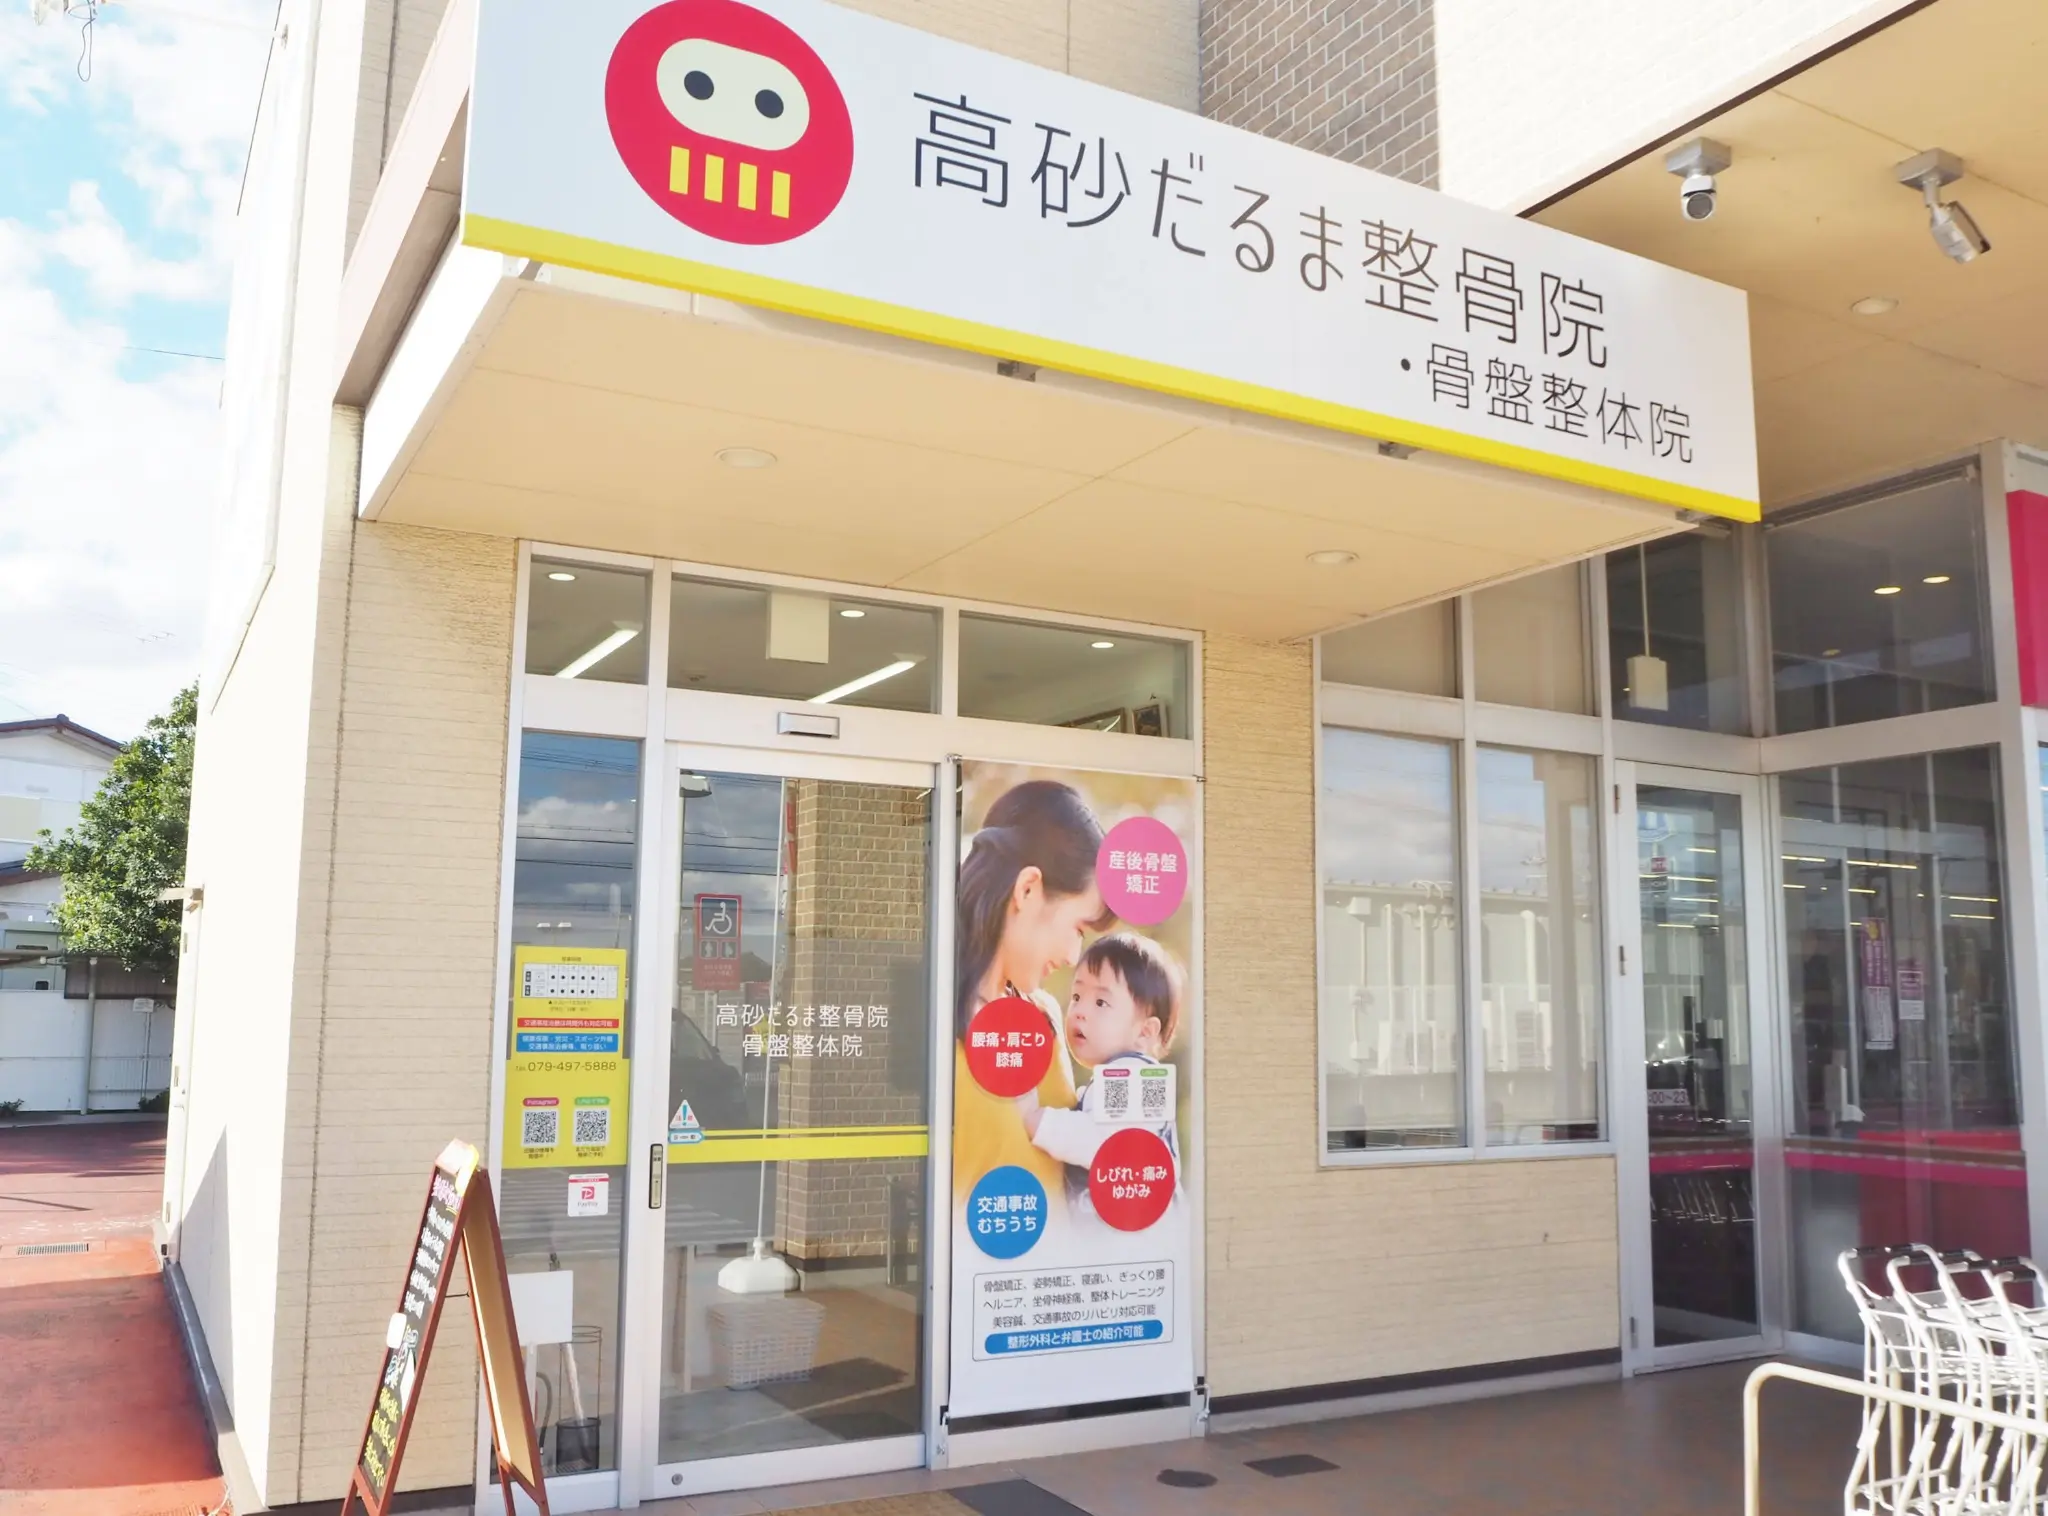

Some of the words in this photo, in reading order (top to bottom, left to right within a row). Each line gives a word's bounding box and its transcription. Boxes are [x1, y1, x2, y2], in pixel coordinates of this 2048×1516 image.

[913, 94, 1607, 368] 高砂だるま整骨院
[1108, 850, 1178, 873] 産後骨盤
[1126, 875, 1161, 895] 矯正
[715, 1001, 889, 1029] 高砂だるま整骨院
[742, 1033, 863, 1058] 骨盤整体院
[971, 1031, 1046, 1048] 腰痛・肩こり
[527, 1061, 616, 1071] 079-497-5888
[995, 1051, 1024, 1068] 膝痛
[1096, 1165, 1168, 1183] しびれ・痛み
[1112, 1184, 1151, 1200] ゆがみ
[977, 1193, 1038, 1215] 交通事故
[977, 1215, 1037, 1235] むちうち
[1006, 1324, 1145, 1351] 整形外科と弁護士の紹介可能
